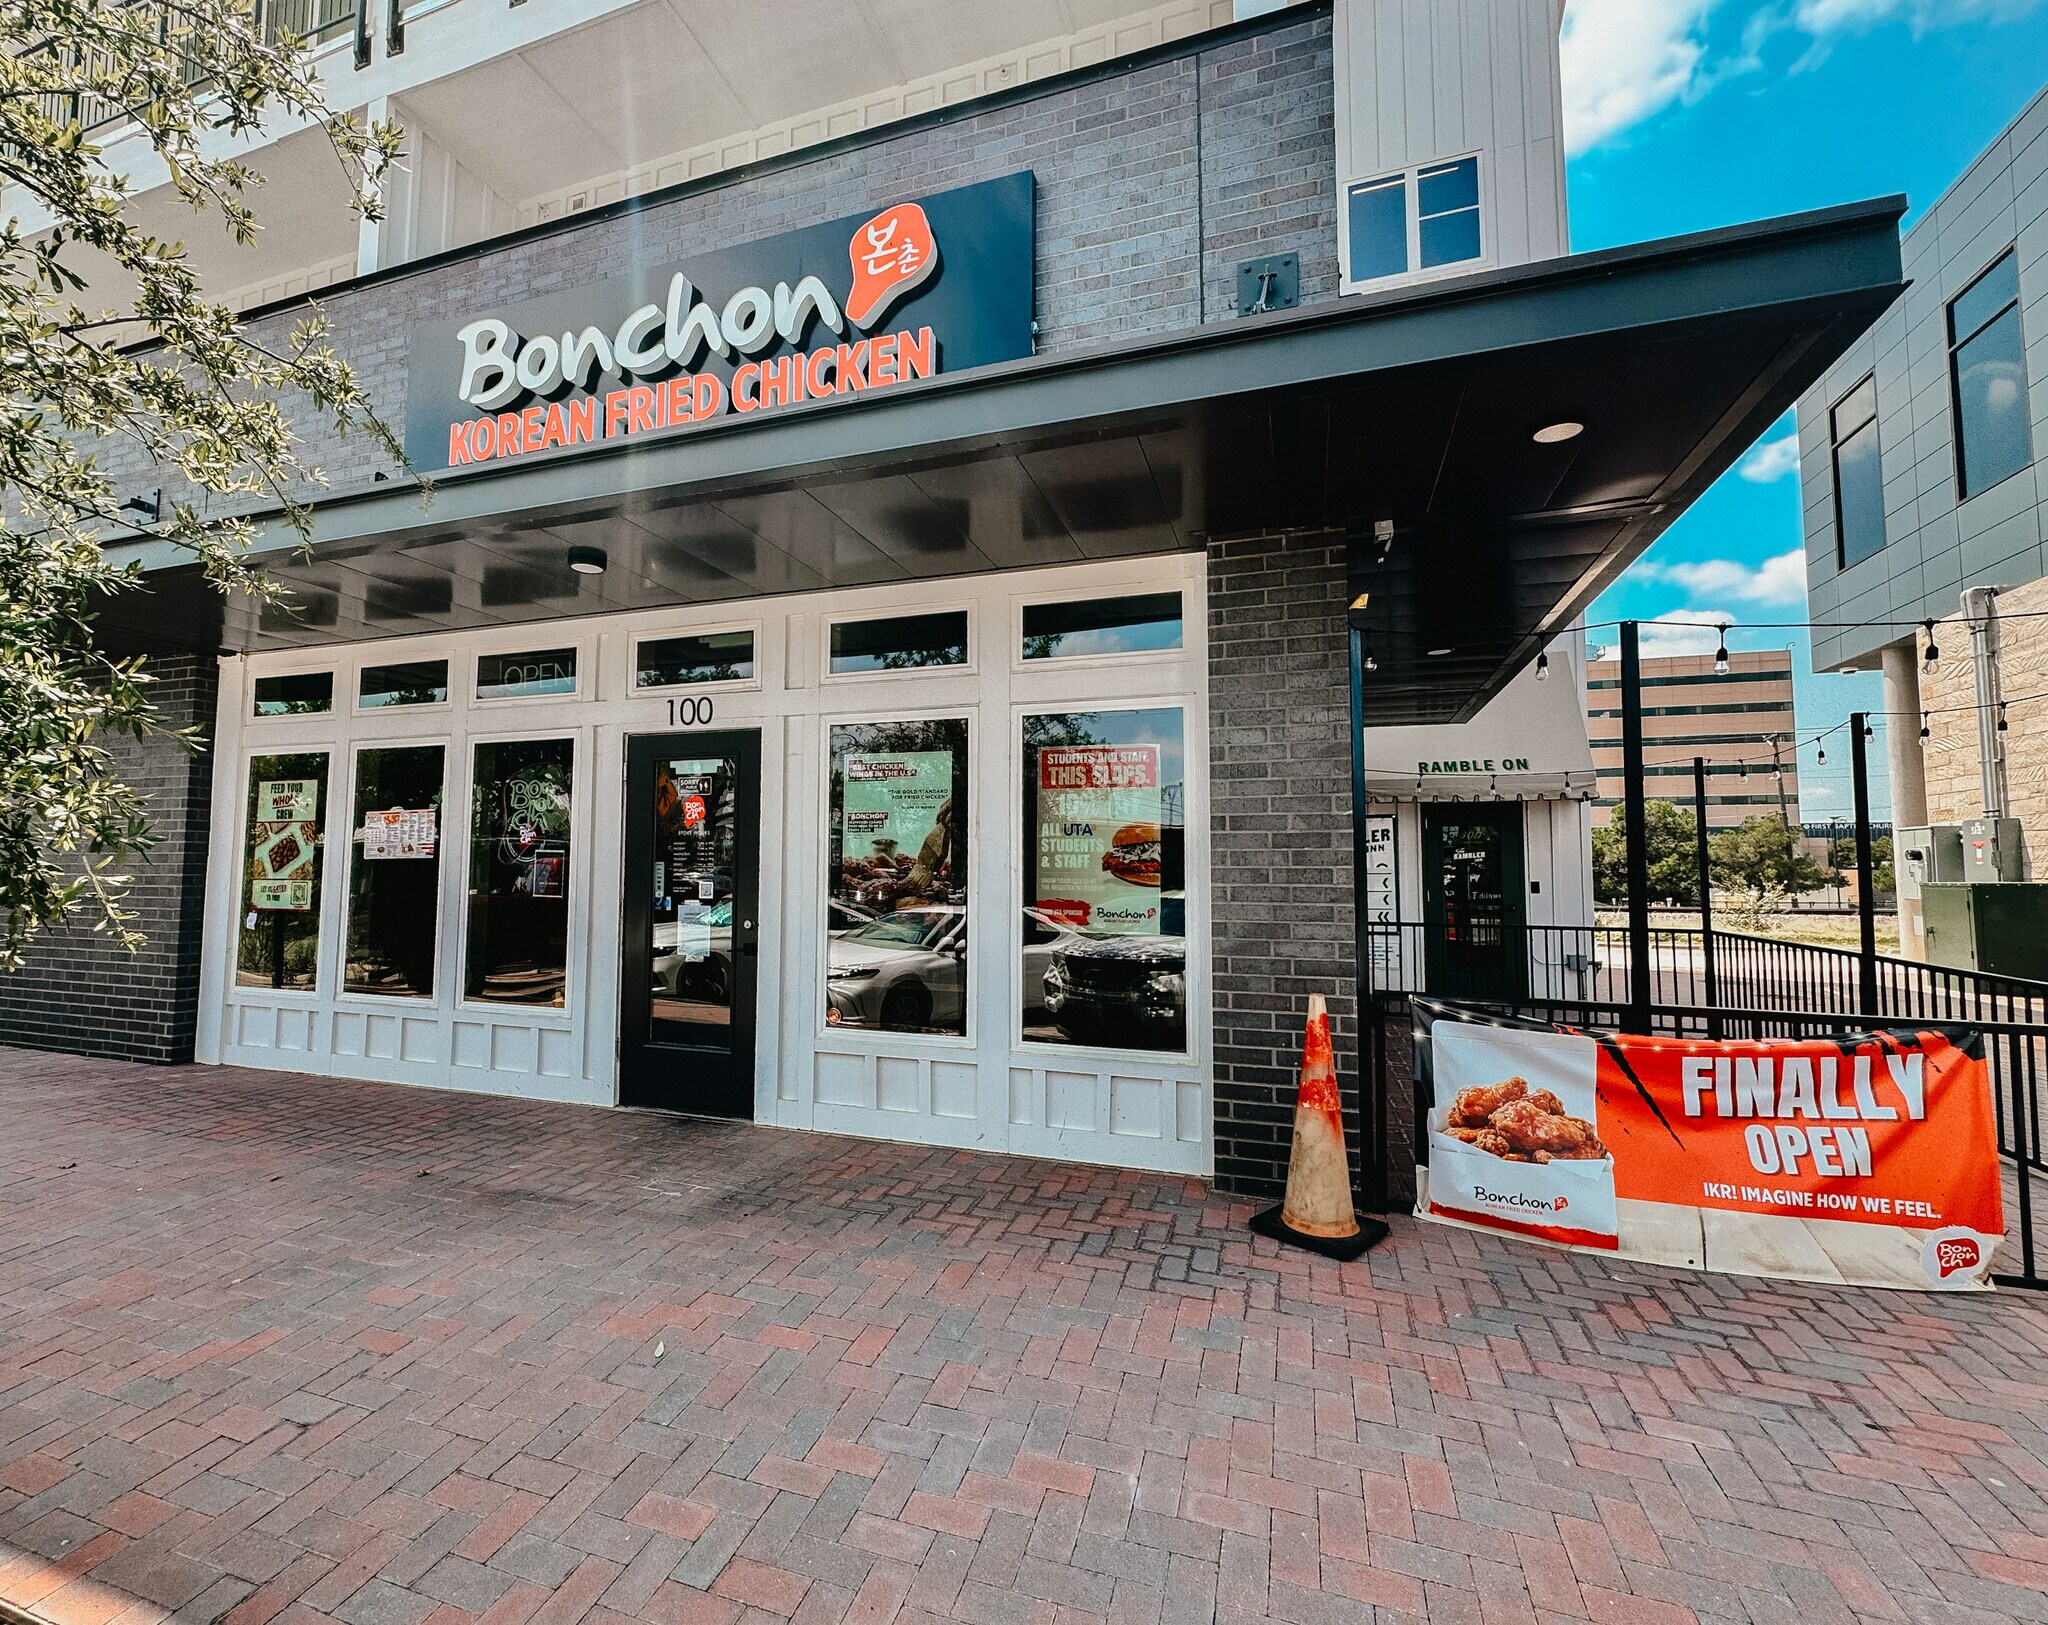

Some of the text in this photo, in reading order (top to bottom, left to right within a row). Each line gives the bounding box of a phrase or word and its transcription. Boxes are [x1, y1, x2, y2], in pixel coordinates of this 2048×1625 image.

[456, 271, 842, 408] Bonchon
[447, 326, 935, 468] KOREAN FRIED CHICKEN
[503, 661, 573, 691] OPEN
[666, 696, 714, 726] 100
[1047, 752, 1095, 765] STUDENTS
[1097, 751, 1118, 763] AND
[1418, 758, 1529, 773] RAMBLE ON
[871, 762, 905, 770] CHICKEN
[884, 769, 899, 777] THE
[1048, 764, 1151, 785] THIS SLAPS.
[271, 783, 285, 794] FEED
[276, 809, 294, 820] CREW
[1041, 822, 1094, 837] ALL UTA
[1041, 838, 1105, 853] STUDENTS
[1041, 854, 1091, 869] & STAFF
[1096, 907, 1147, 919] Bonchon
[1682, 1053, 1925, 1120] FINALLY
[1744, 1124, 1872, 1177] OPEN
[1473, 1186, 1553, 1211] Bonchon
[1702, 1182, 1942, 1219] IKR! IMAGINE HOW WE FEEL.
